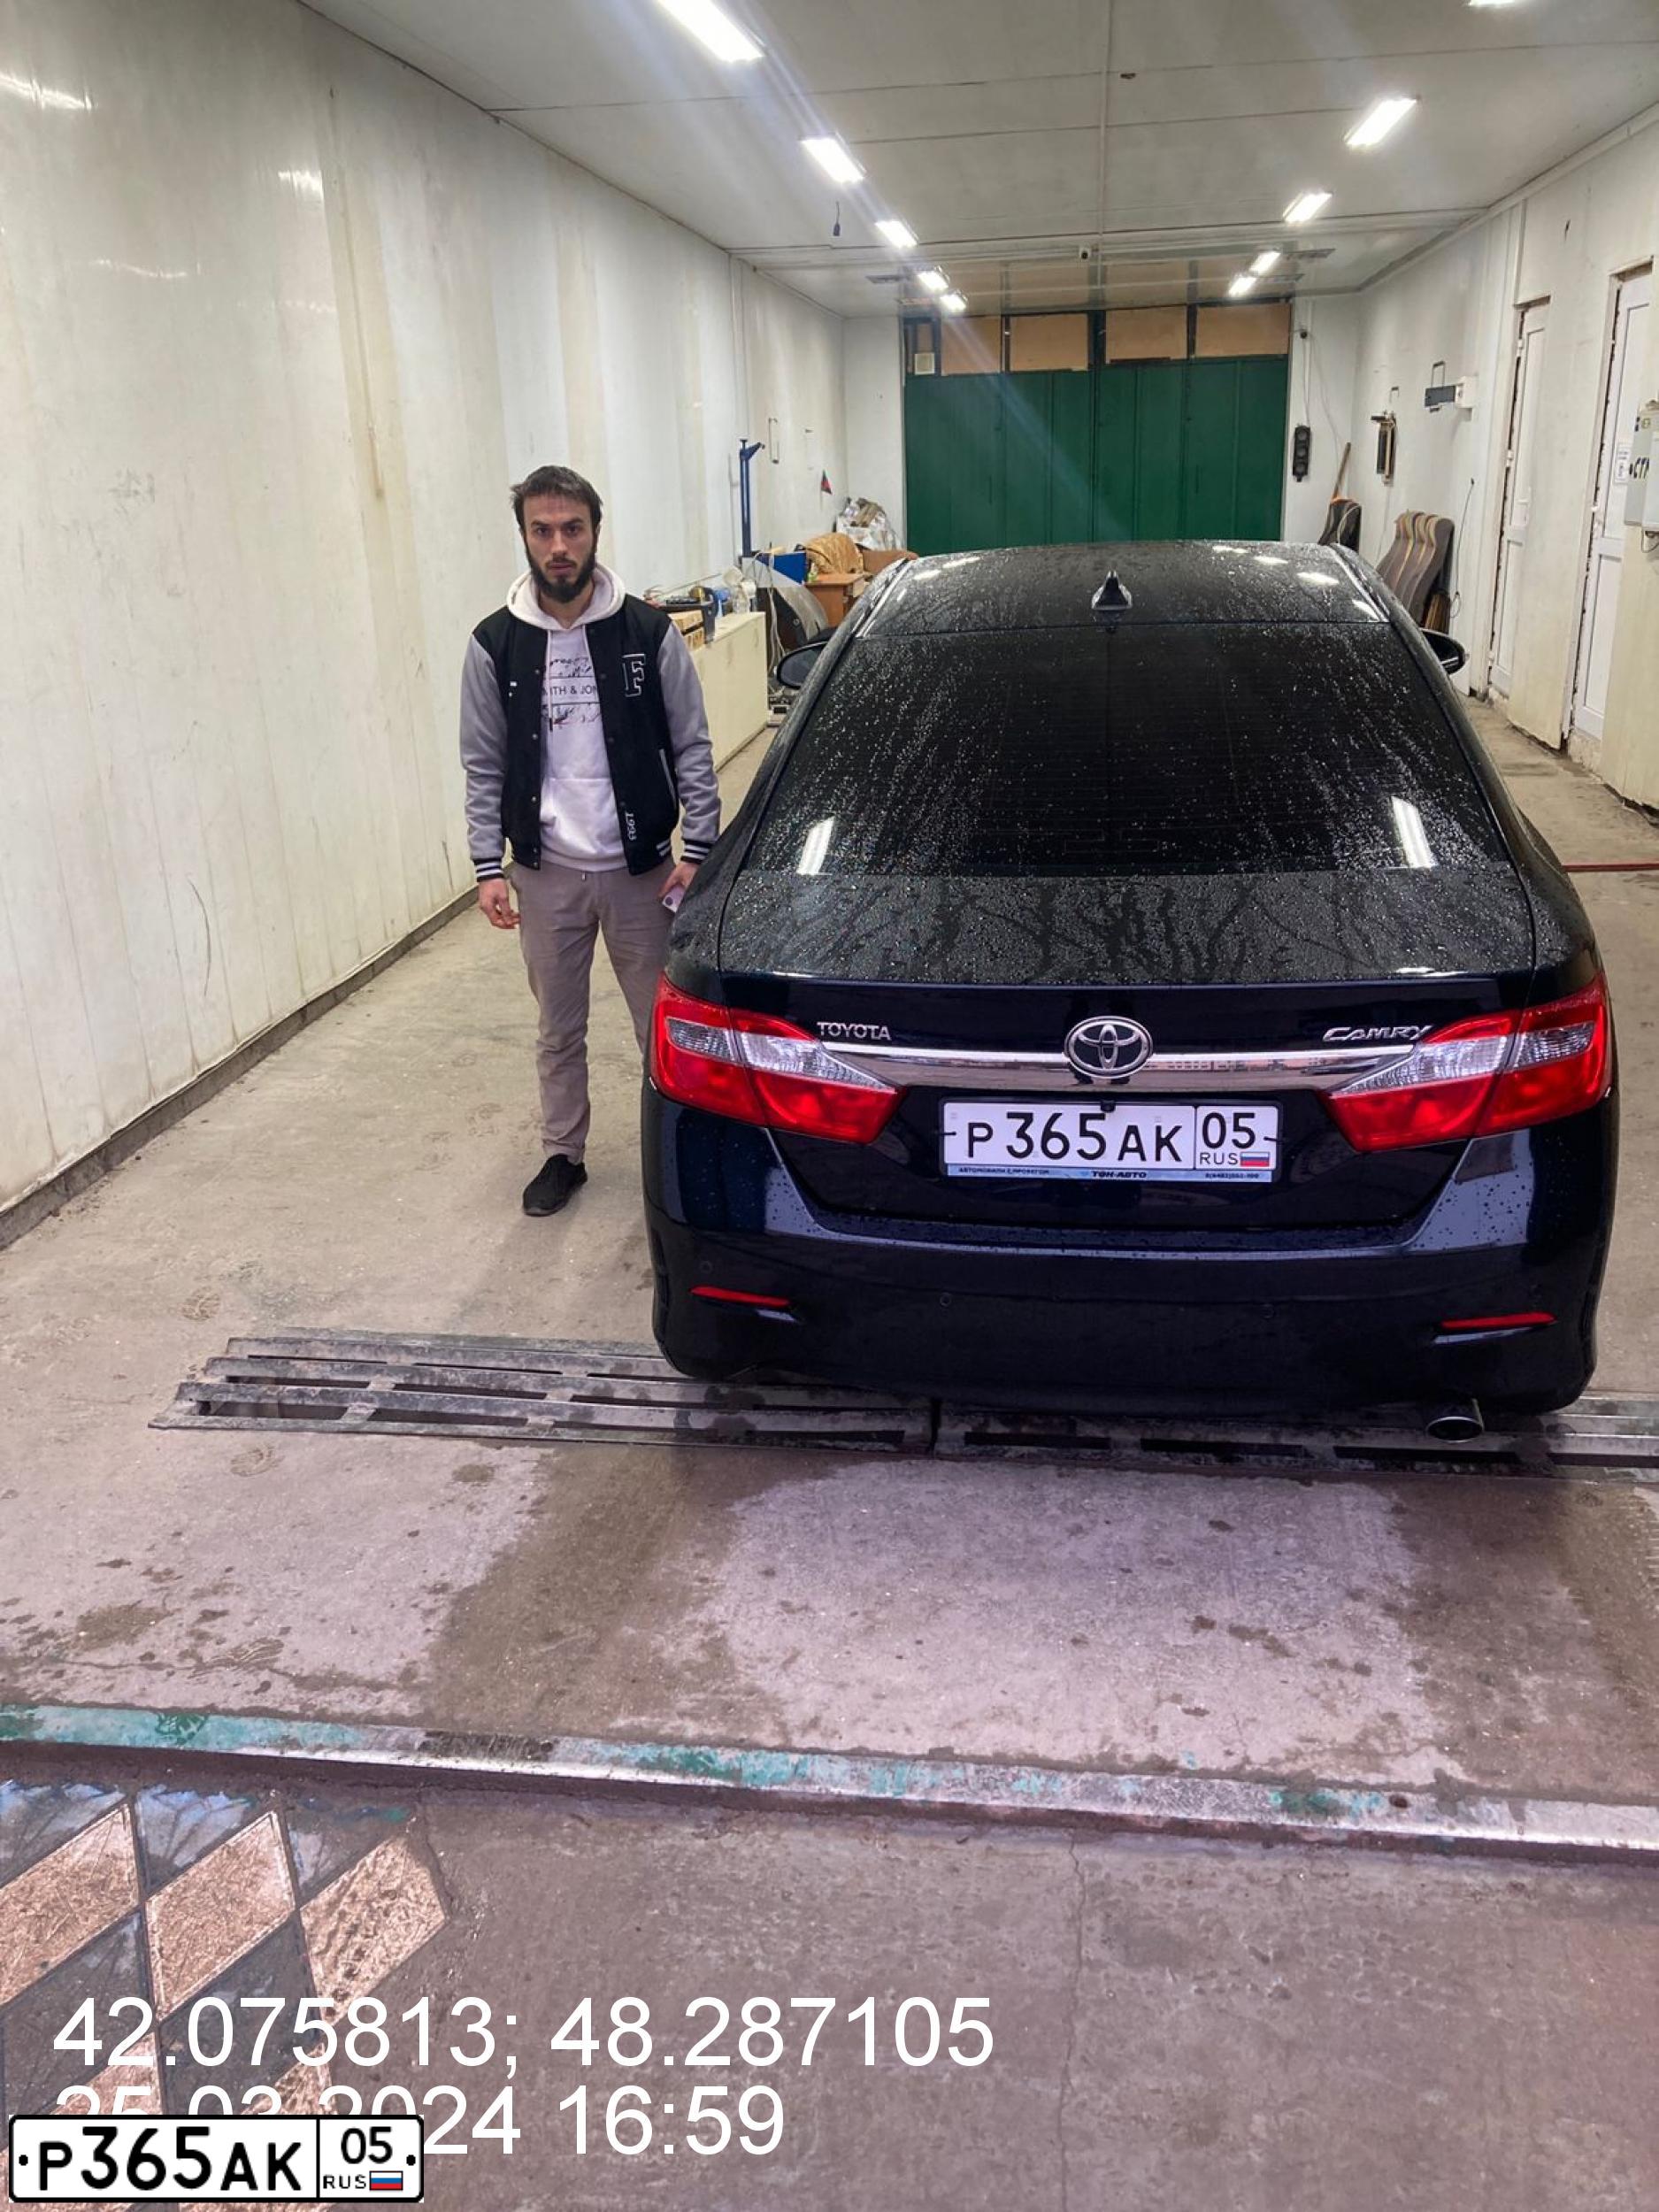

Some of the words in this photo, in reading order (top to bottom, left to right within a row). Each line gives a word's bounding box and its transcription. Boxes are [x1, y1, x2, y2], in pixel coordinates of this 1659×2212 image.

[570, 686, 577, 695] &
[817, 1021, 892, 1041] TOYOTA
[1322, 1025, 1433, 1041] CAMRY
[1202, 1112, 1256, 1148] 05
[1200, 1152, 1238, 1165] RUS
